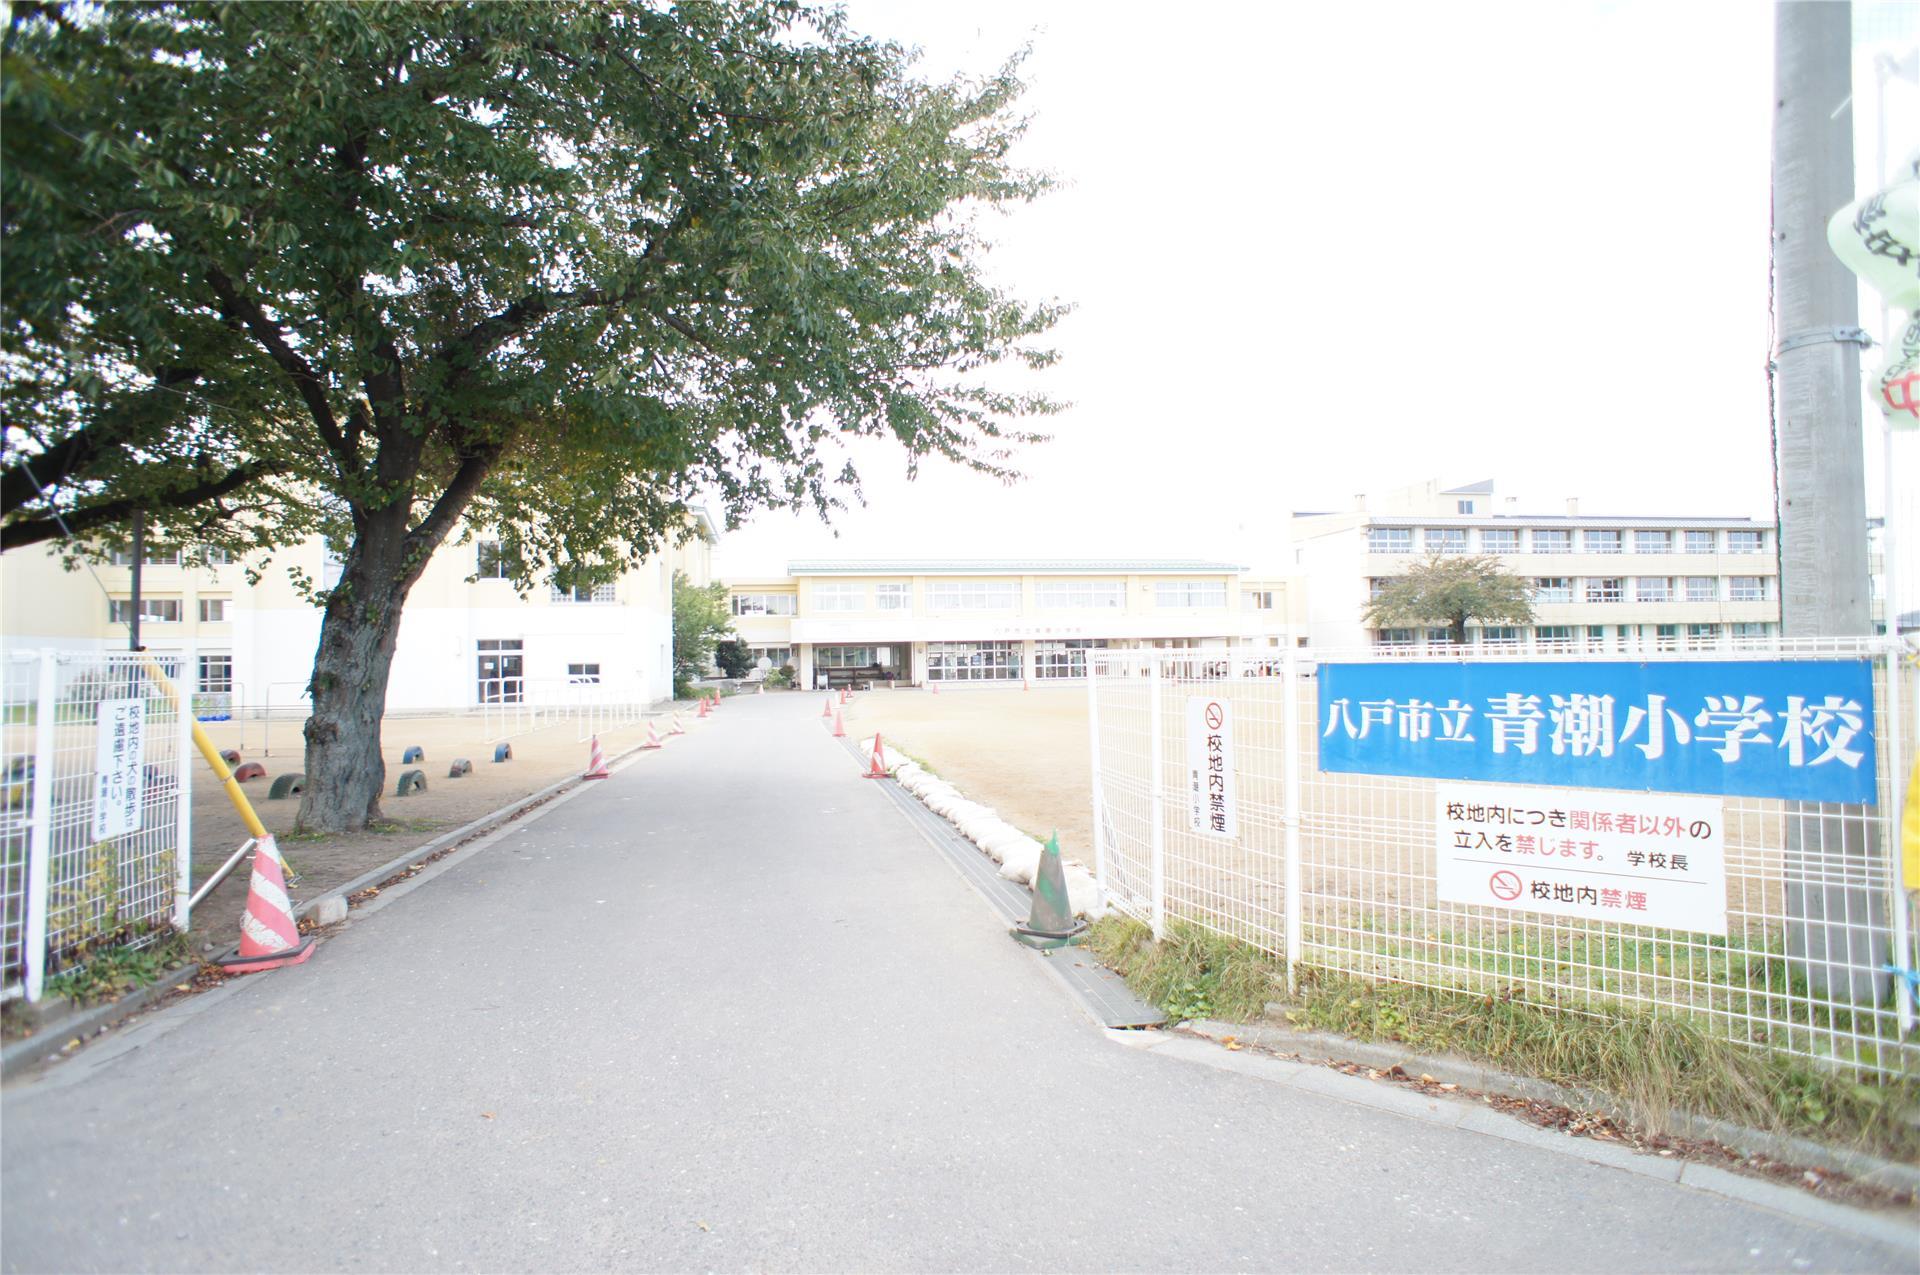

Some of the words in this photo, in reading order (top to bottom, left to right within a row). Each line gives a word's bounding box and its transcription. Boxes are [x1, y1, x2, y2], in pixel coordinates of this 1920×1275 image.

[1323, 692, 1864, 768] 八戸市立青潮小学校
[1207, 734, 1226, 832] 校地内禁煙
[1446, 802, 1712, 840] 校地内につき関係者以外の
[1453, 830, 1607, 864] 立入を禁じます。
[1627, 850, 1688, 872] 学校長
[1530, 881, 1647, 911] 校地内禁煙
